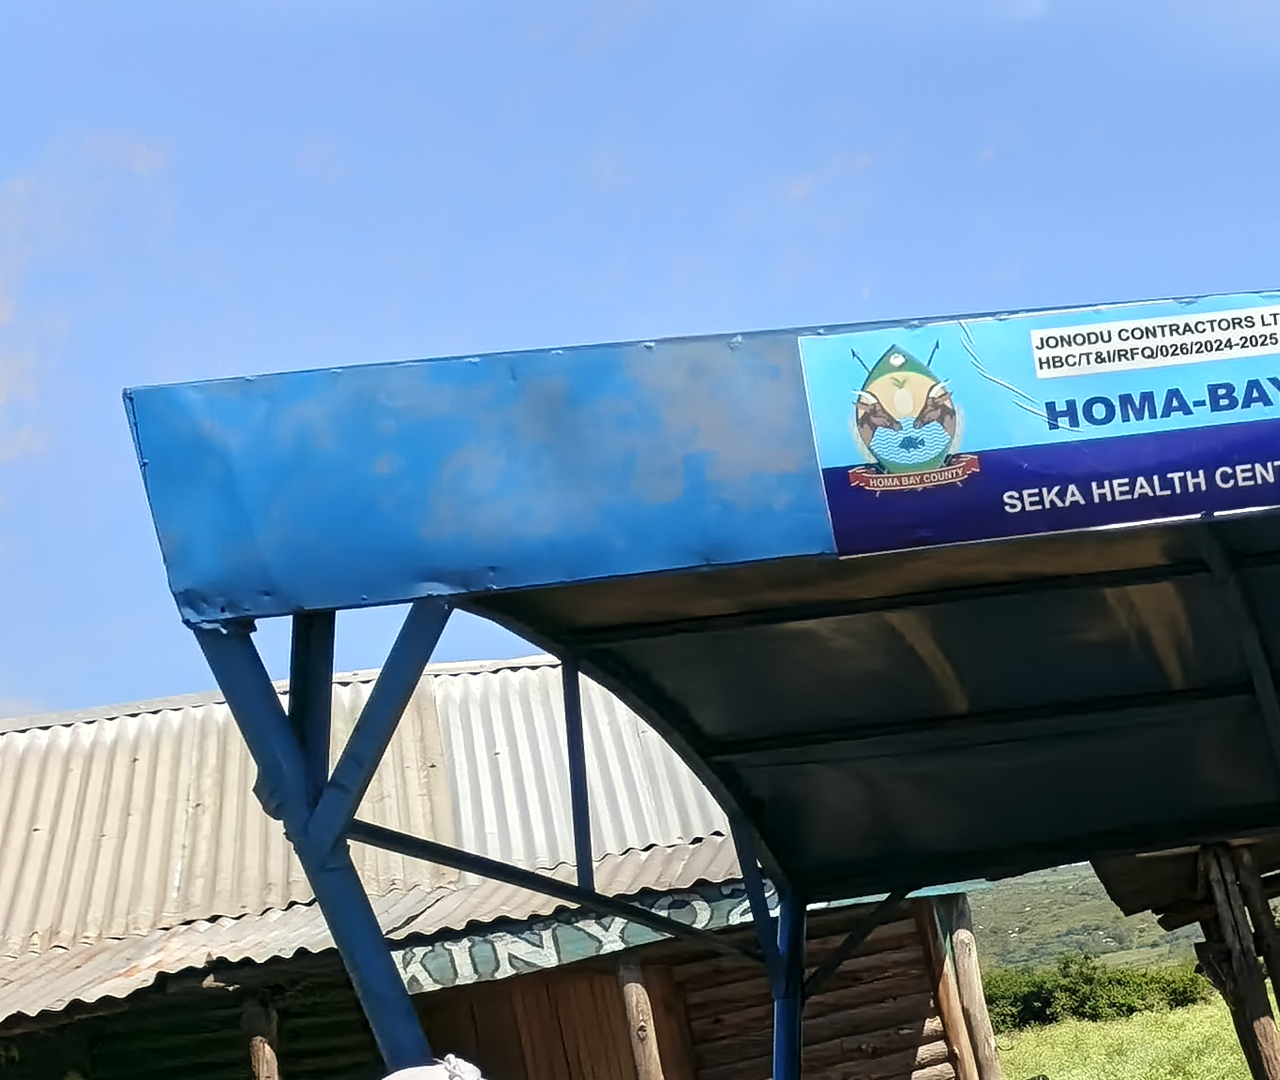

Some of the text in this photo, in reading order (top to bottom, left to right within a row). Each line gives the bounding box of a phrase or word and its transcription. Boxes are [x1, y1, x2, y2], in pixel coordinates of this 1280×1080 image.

[1035, 328, 1113, 351] JONODU
[1117, 316, 1256, 342] CONTRACTORS
[1037, 332, 1280, 371] HBC/T&I/RFQ/026/2024-2025
[869, 467, 964, 488] HOMA BAY COUNTY
[1002, 484, 1088, 514] SEKA
[1092, 469, 1206, 503] HEALTH
